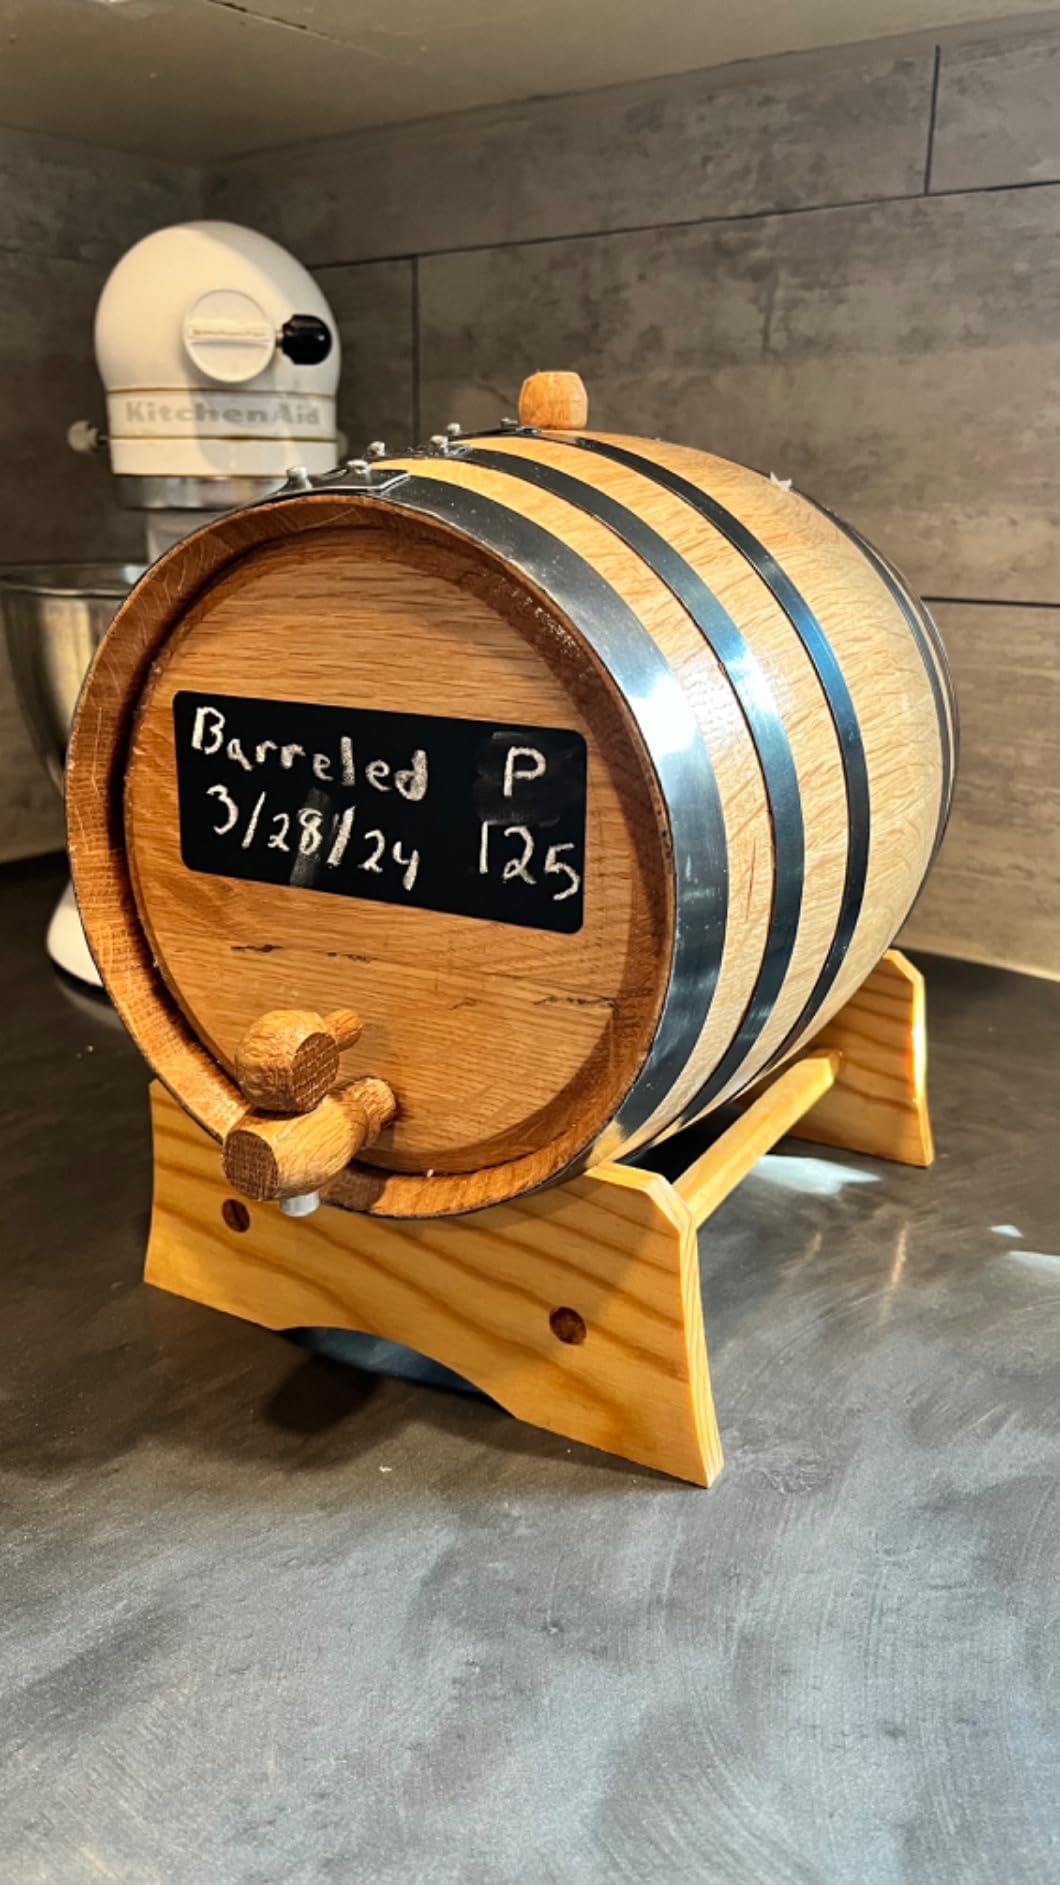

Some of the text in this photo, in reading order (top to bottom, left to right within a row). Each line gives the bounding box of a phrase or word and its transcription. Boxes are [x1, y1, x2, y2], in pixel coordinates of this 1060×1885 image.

[125, 401, 320, 425] KitchenAid
[191, 706, 428, 801] Barreled
[504, 746, 547, 797] P
[206, 785, 419, 891] 3/28/24
[479, 820, 581, 901] 125
